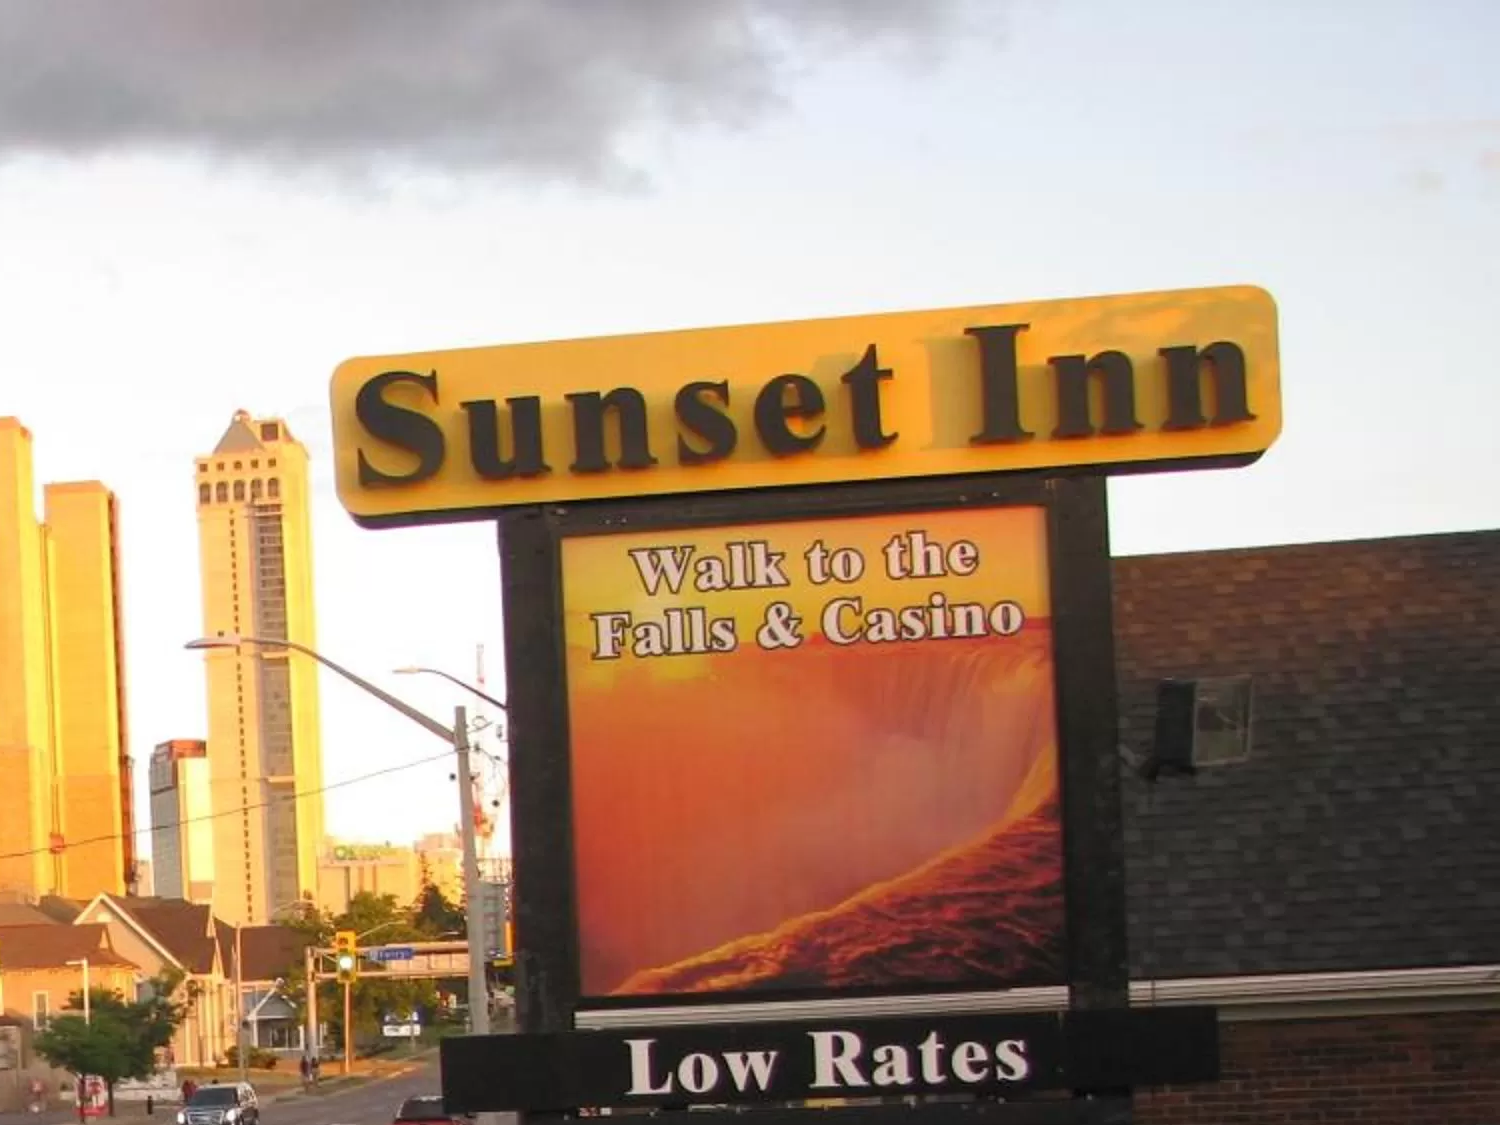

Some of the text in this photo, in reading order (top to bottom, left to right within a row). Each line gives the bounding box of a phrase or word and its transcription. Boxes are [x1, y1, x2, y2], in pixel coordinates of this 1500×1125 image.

[355, 322, 1258, 490] Sunset Inn
[627, 530, 981, 597] Walk to the
[591, 592, 1026, 663] Falls & Casino
[623, 1029, 1031, 1097] Low Rates
